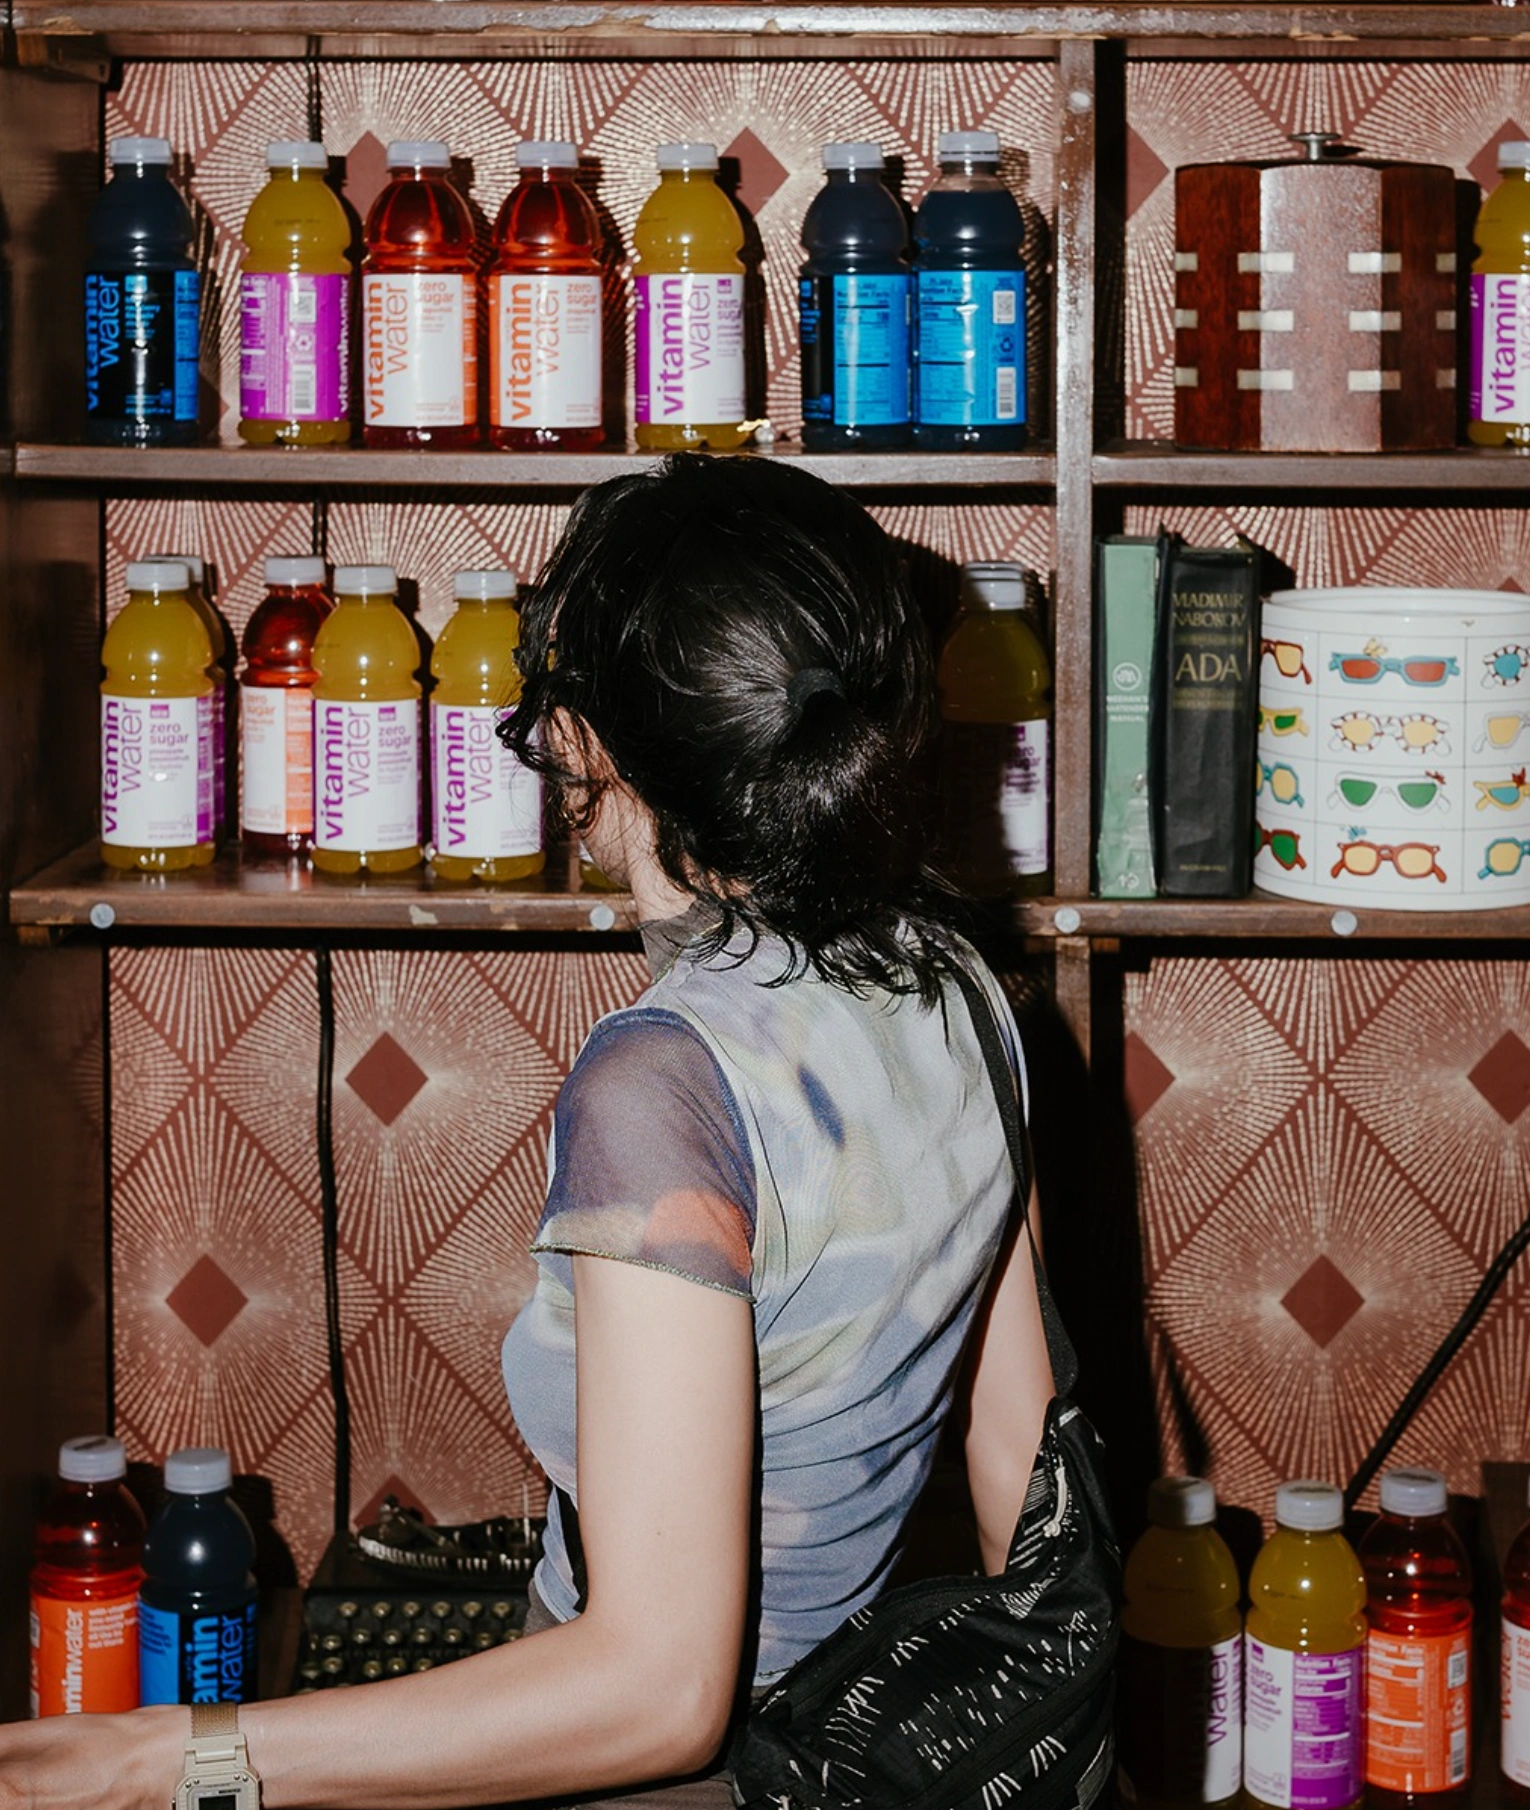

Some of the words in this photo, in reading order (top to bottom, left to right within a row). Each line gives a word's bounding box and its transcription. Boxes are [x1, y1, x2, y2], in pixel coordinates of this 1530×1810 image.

[99, 276, 120, 369] water
[365, 281, 384, 420] vitamin
[386, 282, 409, 376] water
[506, 282, 532, 421] vitamin
[657, 278, 684, 417] vitamin
[1488, 278, 1517, 413] vitamin
[1175, 652, 1242, 682] ADA
[103, 701, 119, 834] vitamin
[121, 702, 142, 793] water
[150, 723, 182, 734] zero
[150, 733, 190, 747] sugar
[321, 706, 344, 840] vitamin
[346, 707, 371, 798] water
[378, 725, 406, 737] zero
[378, 735, 412, 749] sugar
[469, 711, 493, 804] water
[442, 711, 466, 848] vitamin
